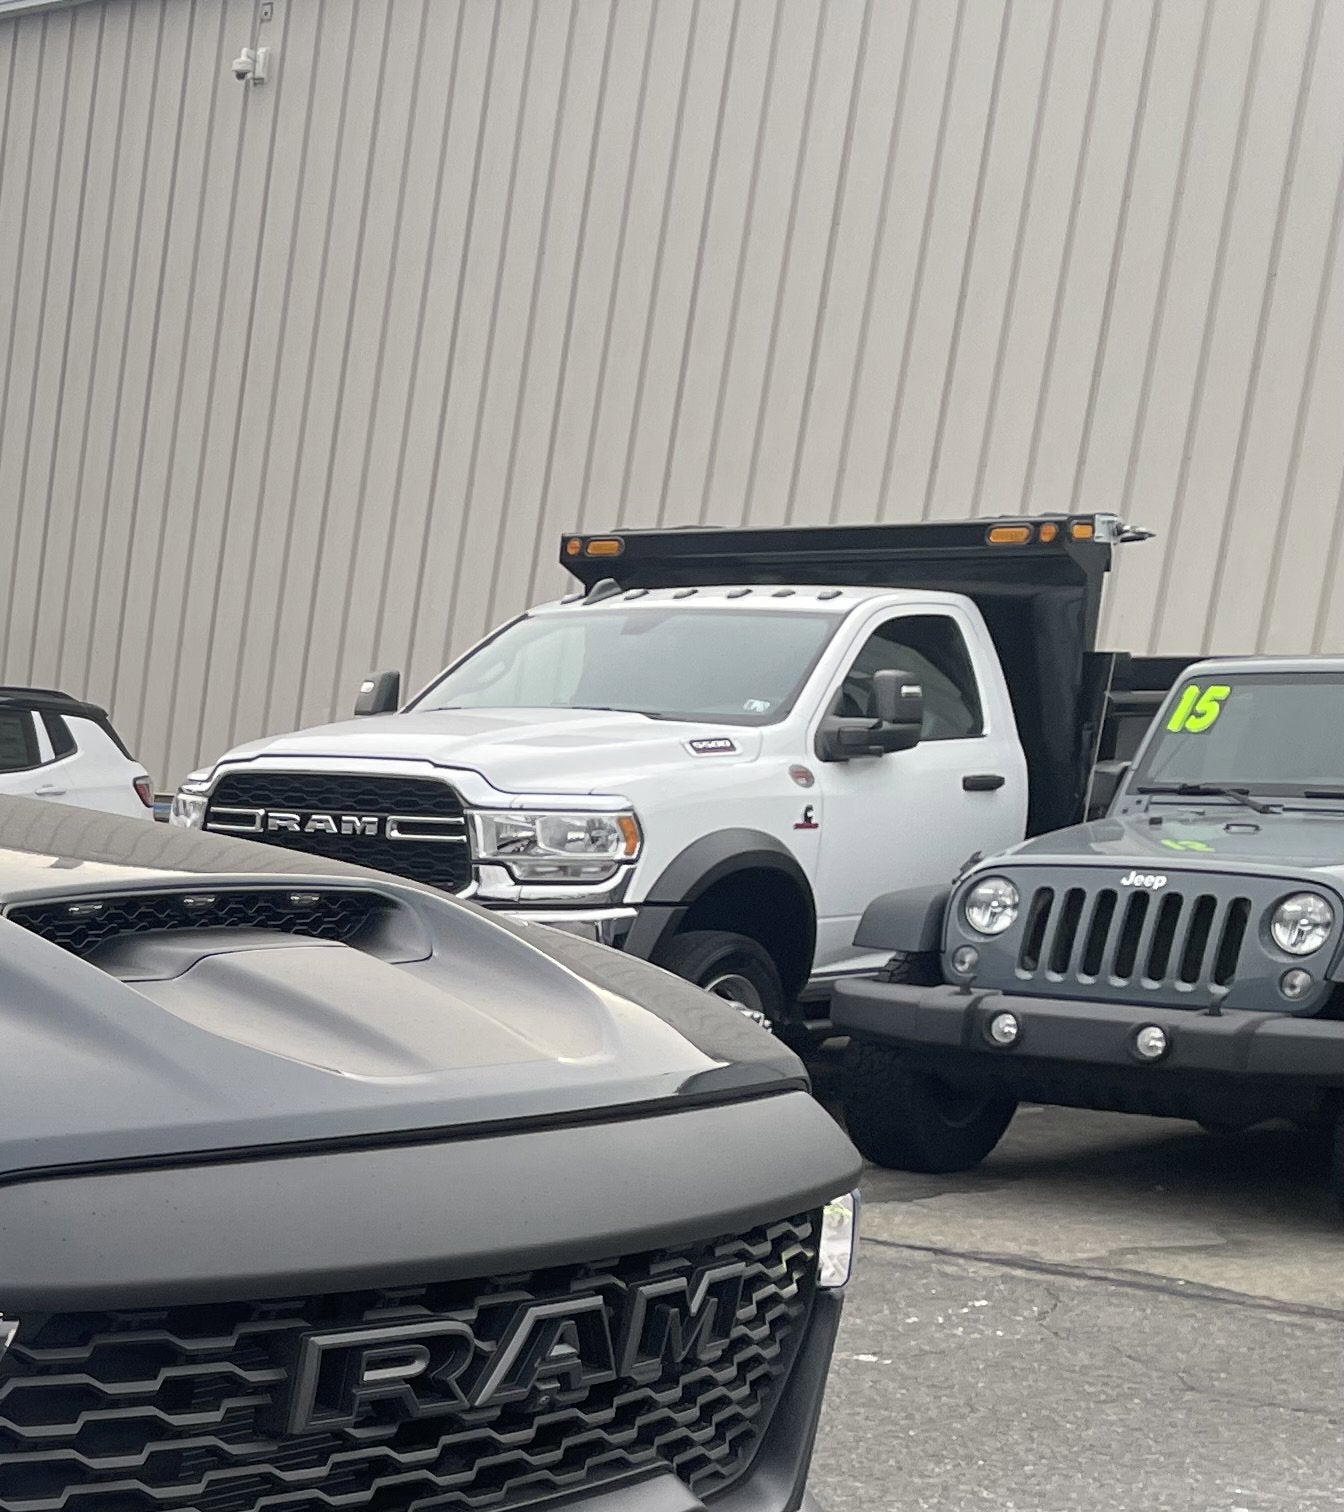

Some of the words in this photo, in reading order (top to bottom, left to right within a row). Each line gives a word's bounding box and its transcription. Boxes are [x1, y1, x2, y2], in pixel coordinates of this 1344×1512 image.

[1166, 683, 1232, 733] 15
[268, 812, 379, 835] RAM
[1119, 870, 1168, 890] Jeep
[286, 1260, 748, 1436] RAM
